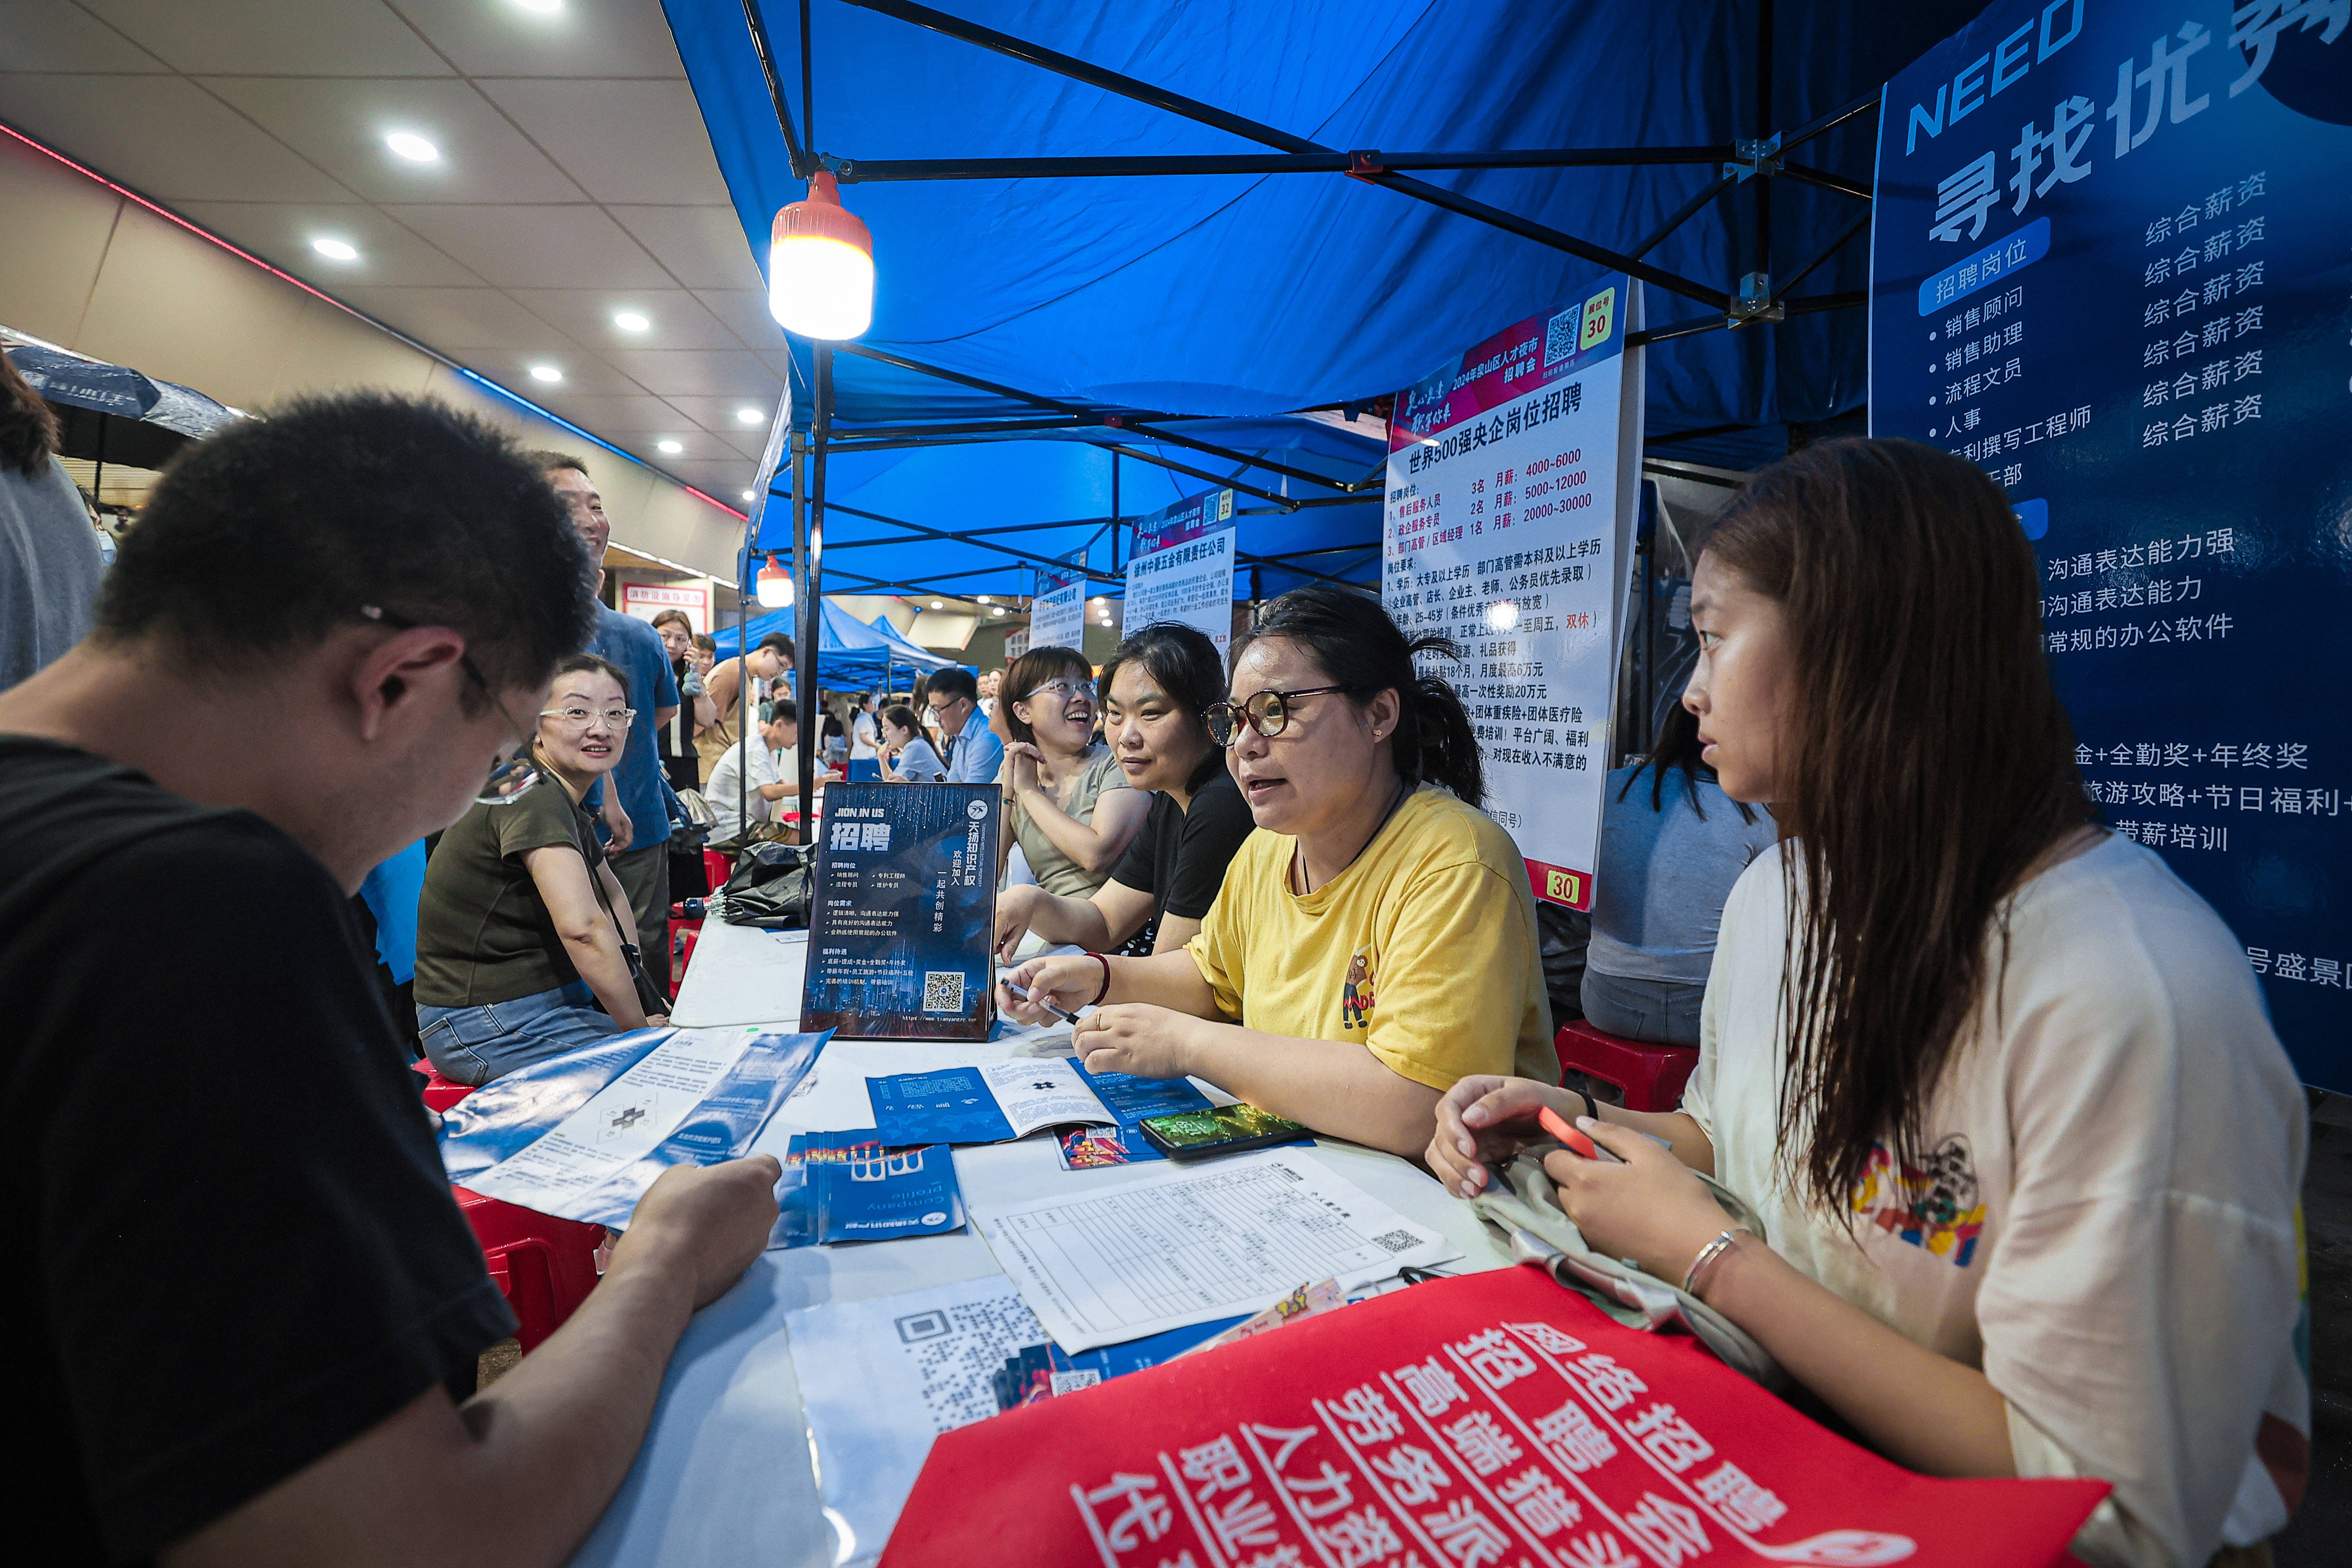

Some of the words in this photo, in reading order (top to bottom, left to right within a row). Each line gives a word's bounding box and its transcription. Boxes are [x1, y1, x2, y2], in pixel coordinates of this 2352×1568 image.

[1906, 0, 2084, 156] NEED
[2146, 171, 2266, 247] 综合薪资
[1936, 239, 2027, 304] 招聘岗位
[2144, 216, 2265, 288] 综合薪资
[1945, 286, 2023, 338] 销售顾问
[2144, 260, 2264, 328] 综合薪资
[1587, 315, 1606, 338] 30
[1945, 321, 2022, 372] 销售助理
[2144, 305, 2263, 368] 综合薪资
[1452, 337, 1537, 391] 2024年泉山区人才夜市
[1504, 356, 1536, 384] 招聘会
[1945, 357, 2021, 405] 流程文员
[2143, 349, 2263, 408] 综合薪资
[1945, 408, 1981, 438] 人事
[2143, 394, 2262, 448] 综合薪资
[1470, 499, 1484, 515] 2名
[1525, 470, 1587, 499] 5000~12000
[1471, 478, 1485, 494] 3名
[1525, 448, 1581, 477] 4000~6000
[1470, 521, 1483, 536] 1名
[1524, 493, 1592, 522] 20000~30000
[2048, 527, 2235, 581] 沟通表达能力强
[2075, 742, 2307, 769] 金+全勤奖+年终奖
[830, 822, 891, 851] 招聘
[835, 808, 858, 817] JION
[859, 808, 870, 818] IN
[871, 808, 885, 818] US
[2116, 819, 2228, 852] 带薪培训
[951, 849, 963, 886] 欢迎加入
[964, 821, 980, 886] 天扬知识产权
[933, 871, 947, 932] 一起共创精彩
[1553, 875, 1573, 899] 30
[867, 1194, 944, 1211] Company
[1509, 1321, 1788, 1533] 网络招聘
